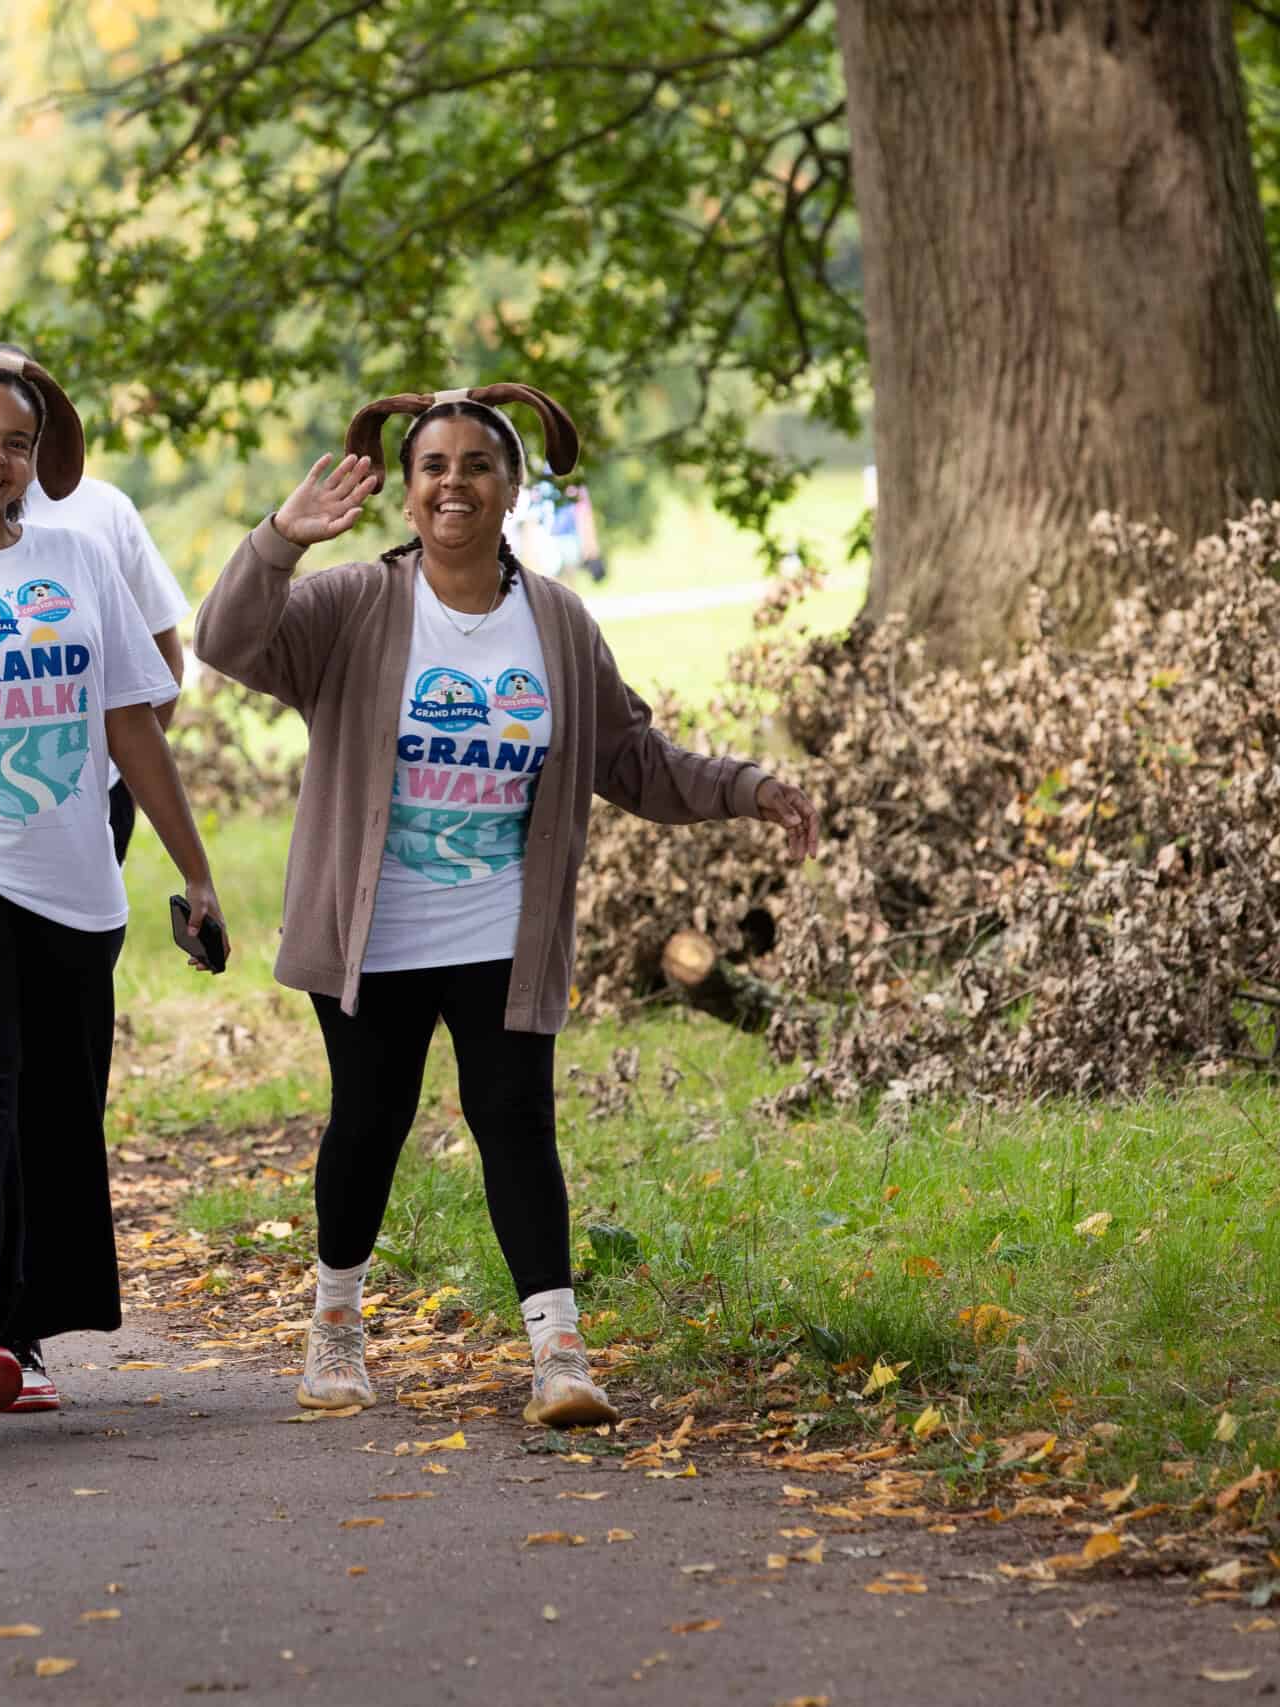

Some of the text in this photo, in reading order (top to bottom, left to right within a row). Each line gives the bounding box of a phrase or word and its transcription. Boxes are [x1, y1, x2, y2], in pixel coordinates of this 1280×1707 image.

[415, 707, 484, 718] GRAND APPEAL
[407, 767, 529, 805] WALK
